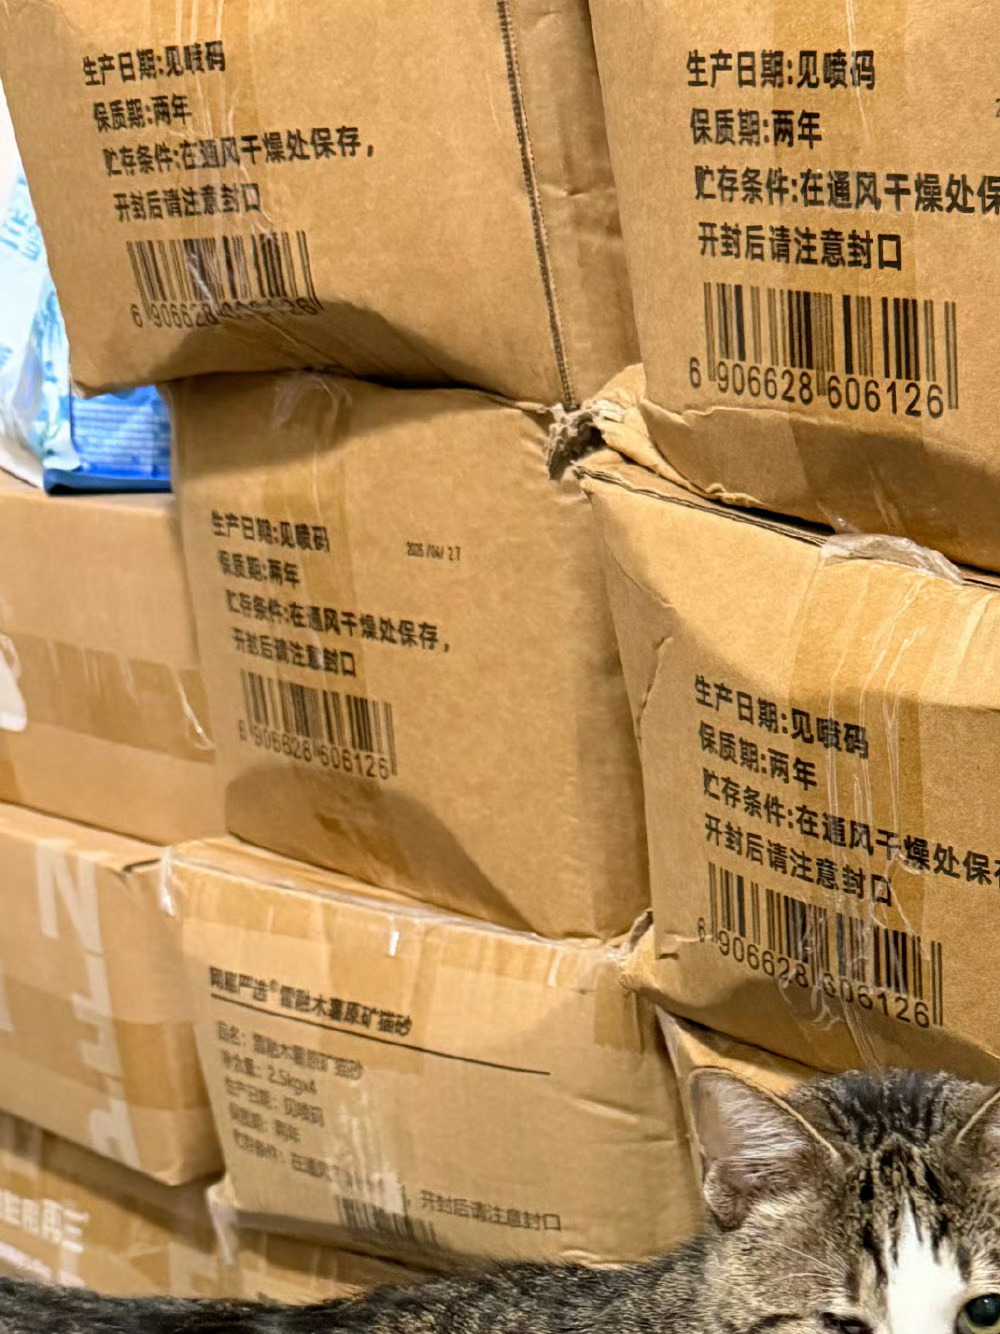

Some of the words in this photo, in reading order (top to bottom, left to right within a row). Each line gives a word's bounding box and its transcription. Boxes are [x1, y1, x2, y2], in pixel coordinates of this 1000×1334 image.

[686, 49, 875, 91] 生产日期:见喷码
[690, 107, 822, 150] 保质期:两年
[114, 182, 261, 222] 开封后请注意封口
[698, 221, 902, 271] 开封后请注意封口
[716, 360, 814, 405] 906628
[827, 375, 945, 419] 606126
[694, 674, 869, 760] 生产日期:见喷码
[698, 720, 818, 791] 保质期:两年
[704, 812, 893, 908] 开封后请注意封口
